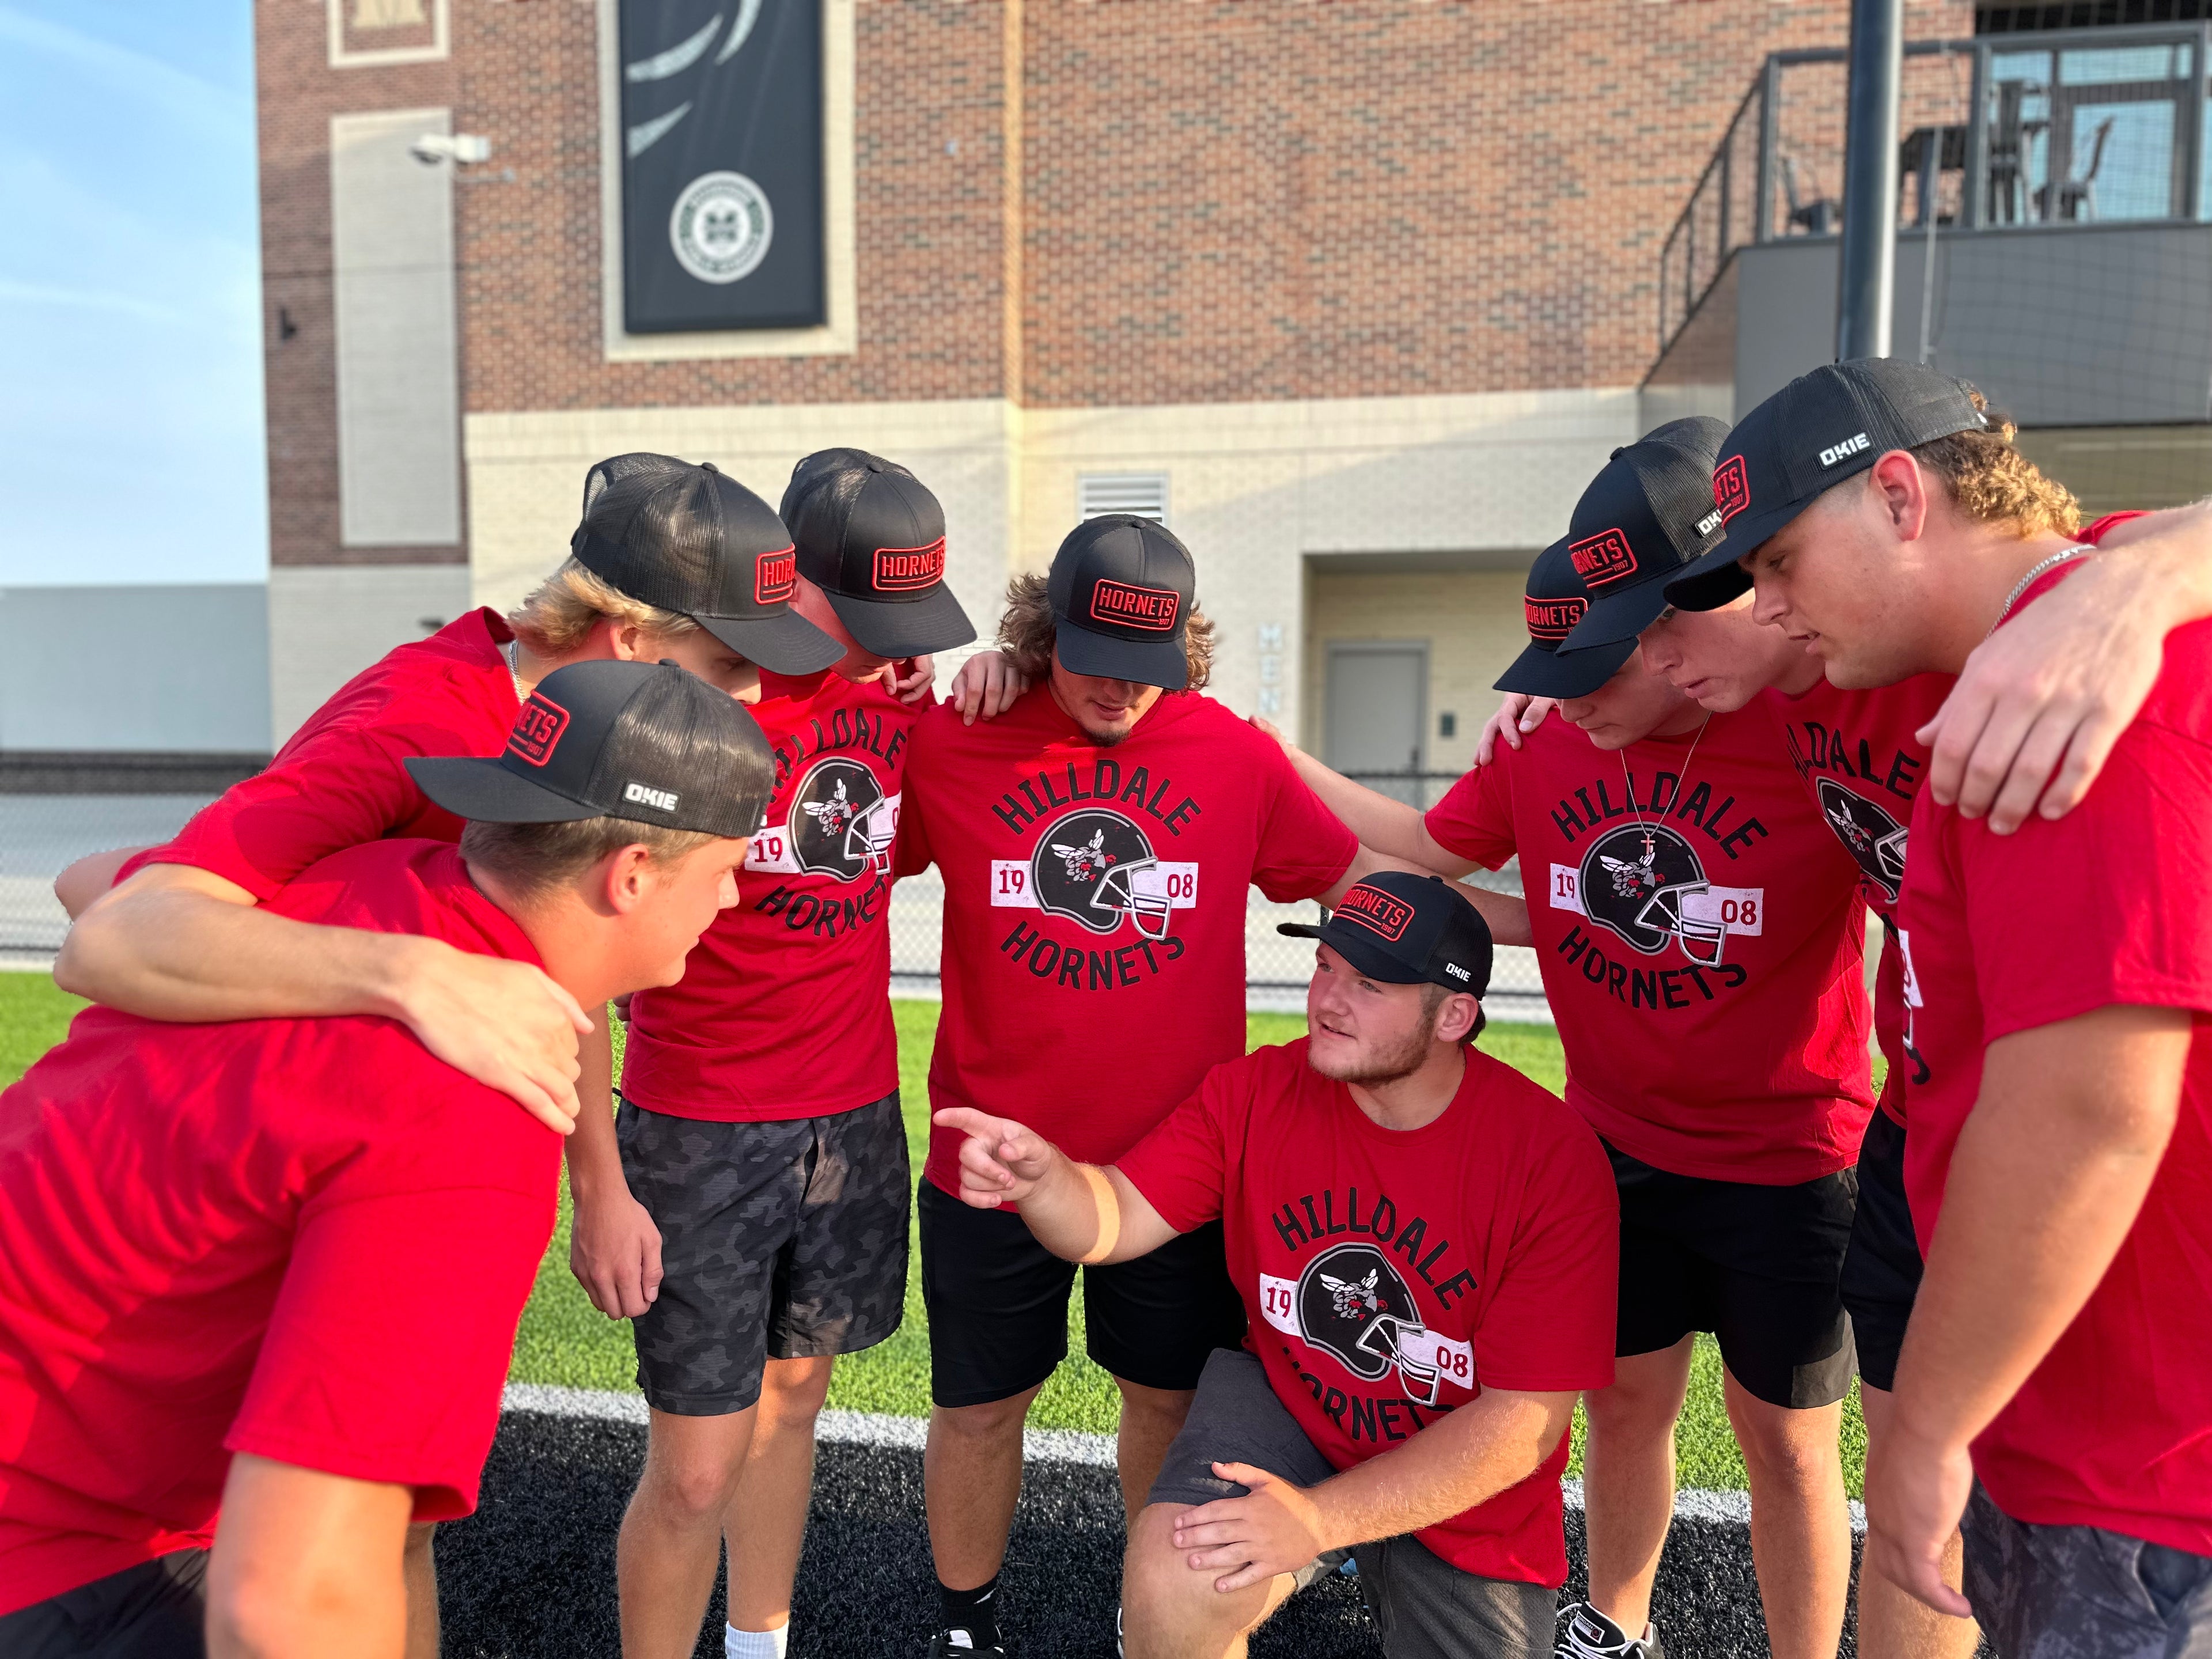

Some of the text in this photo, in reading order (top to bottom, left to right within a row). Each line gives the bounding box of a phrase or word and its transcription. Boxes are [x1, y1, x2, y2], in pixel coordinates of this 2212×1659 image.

[1820, 433, 1870, 466] OKIE
[1697, 509, 1722, 535] OK
[881, 544, 944, 577] HORNETS
[1099, 587, 1175, 618] HORNETS
[1525, 603, 1581, 626] ORNETS
[1256, 622, 1282, 713] MEN
[770, 707, 907, 803] ILLDALE
[625, 783, 678, 811] OKIE
[991, 759, 1202, 836] HILLDALE
[1551, 770, 1769, 860] HILLDALE
[754, 837, 783, 862] 19
[754, 873, 891, 938] HORNET
[999, 869, 1194, 899] 19 08
[1556, 872, 1758, 926] 19 08
[1380, 922, 1396, 935] 1907
[1001, 921, 1185, 991] HORNETS
[1445, 962, 1471, 982] OKIE
[1557, 925, 1748, 1010] HORNETS
[1272, 1187, 1478, 1311] HILLDALE
[1266, 1287, 1469, 1378] 19 08
